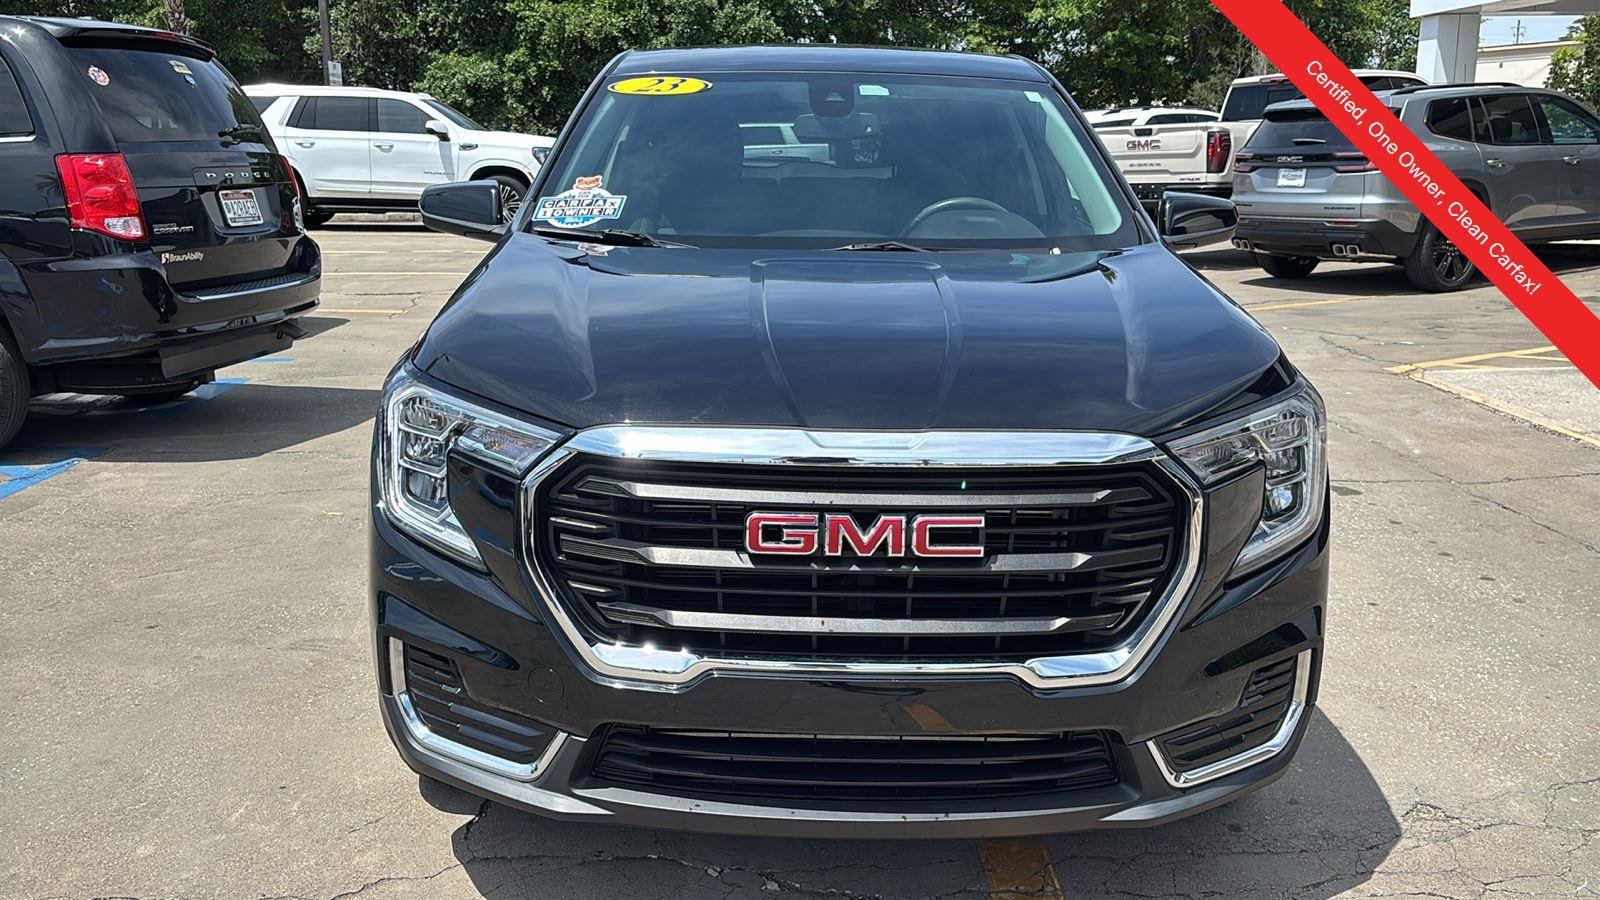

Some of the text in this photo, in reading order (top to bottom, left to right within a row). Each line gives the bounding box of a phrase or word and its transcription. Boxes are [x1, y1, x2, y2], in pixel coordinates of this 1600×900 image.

[634, 78, 687, 92] 23
[1127, 140, 1161, 150] GMC
[543, 199, 617, 208] CARFAX
[553, 208, 616, 217] OWNER
[170, 252, 204, 262] BraunAbility
[745, 511, 986, 557] GMC
